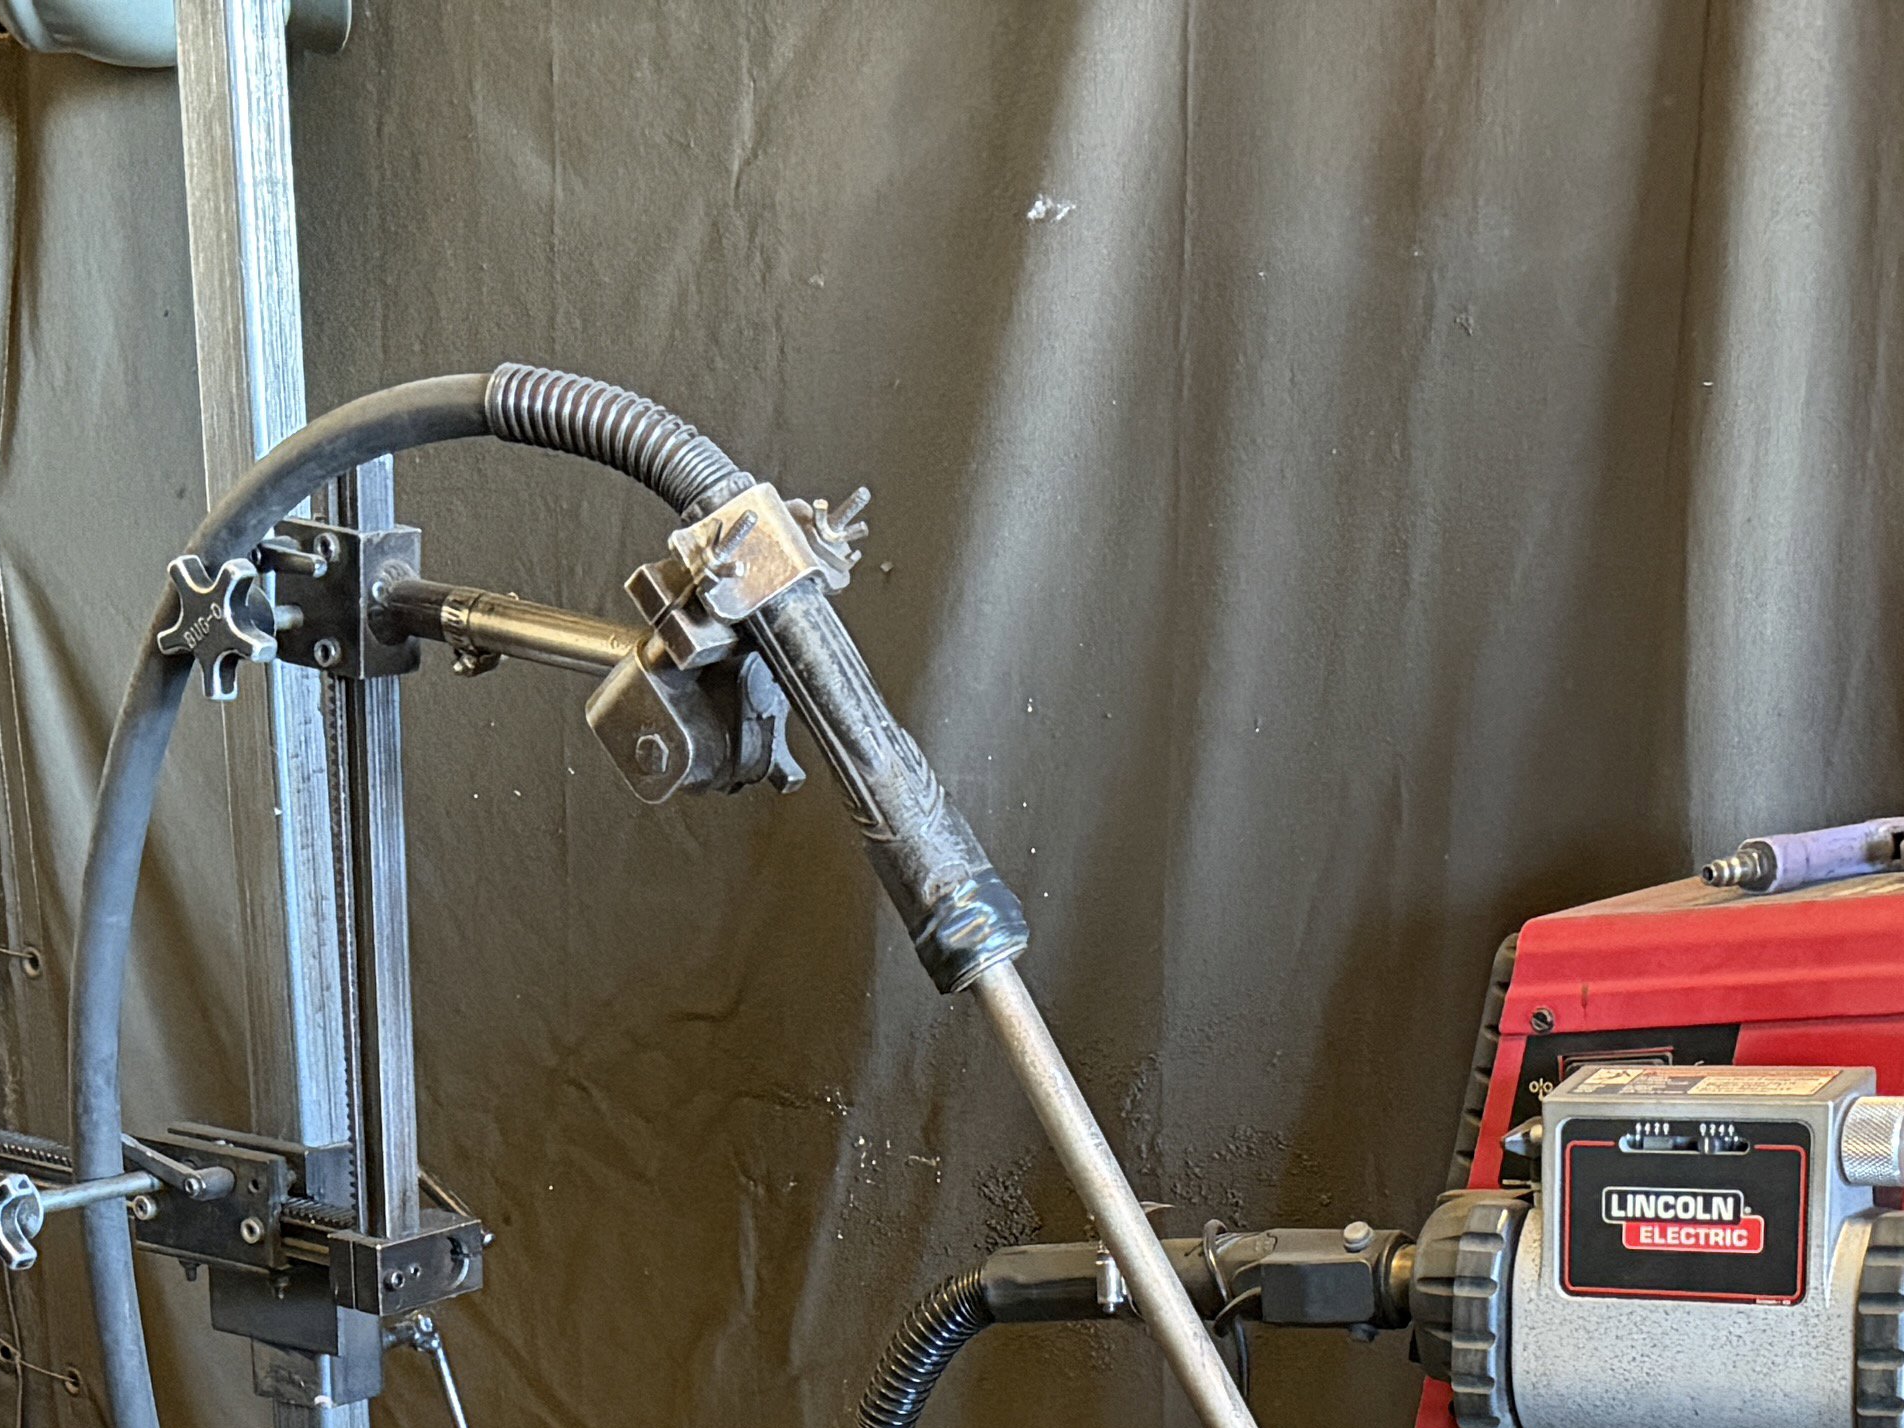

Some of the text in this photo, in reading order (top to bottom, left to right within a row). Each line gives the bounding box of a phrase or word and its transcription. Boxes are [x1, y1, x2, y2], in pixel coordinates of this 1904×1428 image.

[183, 602, 223, 649] BUG-O
[1610, 1193, 1735, 1221] LINCOLN
[1639, 1226, 1748, 1247] ELECTRIC
